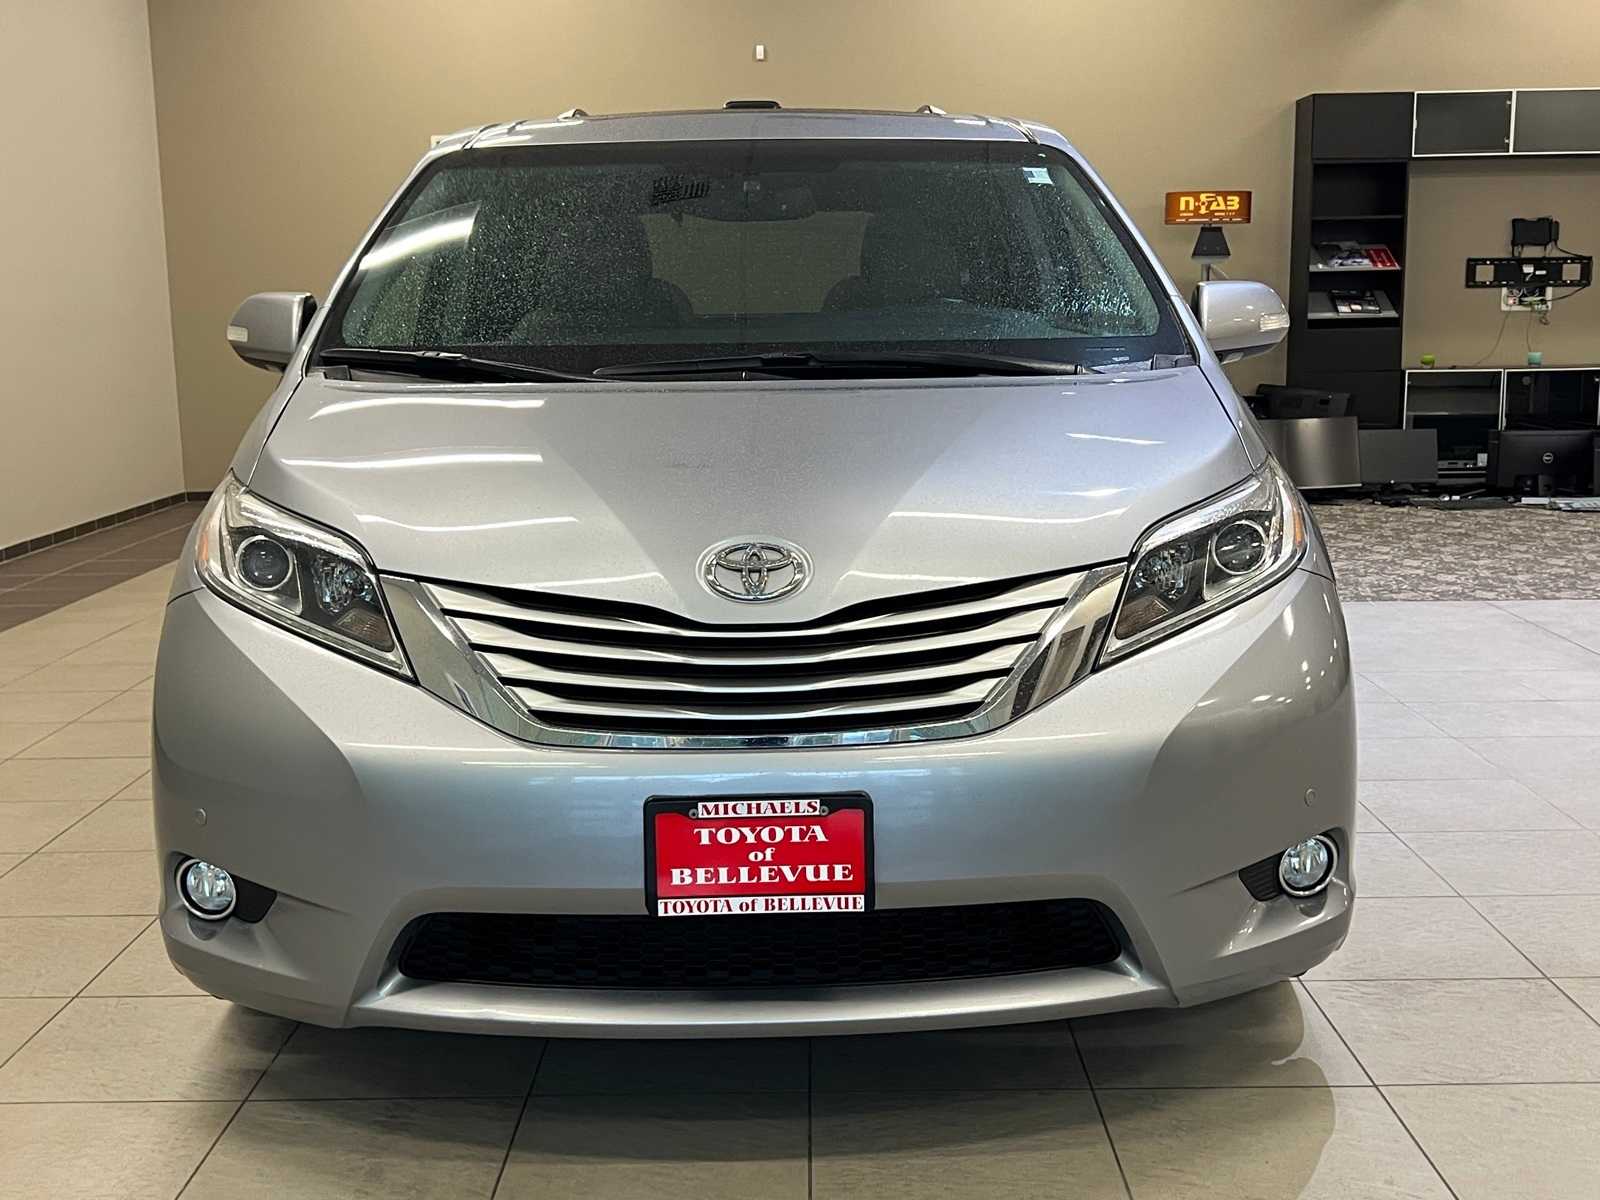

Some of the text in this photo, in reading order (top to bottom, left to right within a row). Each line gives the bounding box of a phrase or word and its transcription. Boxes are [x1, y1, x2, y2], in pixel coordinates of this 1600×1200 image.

[701, 801, 818, 816] MICHAELS
[694, 825, 828, 845] TOYOTA
[748, 847, 776, 862] of
[670, 864, 854, 886] BELLEVUE
[659, 896, 863, 914] TOYOTA of BELLEVUE
